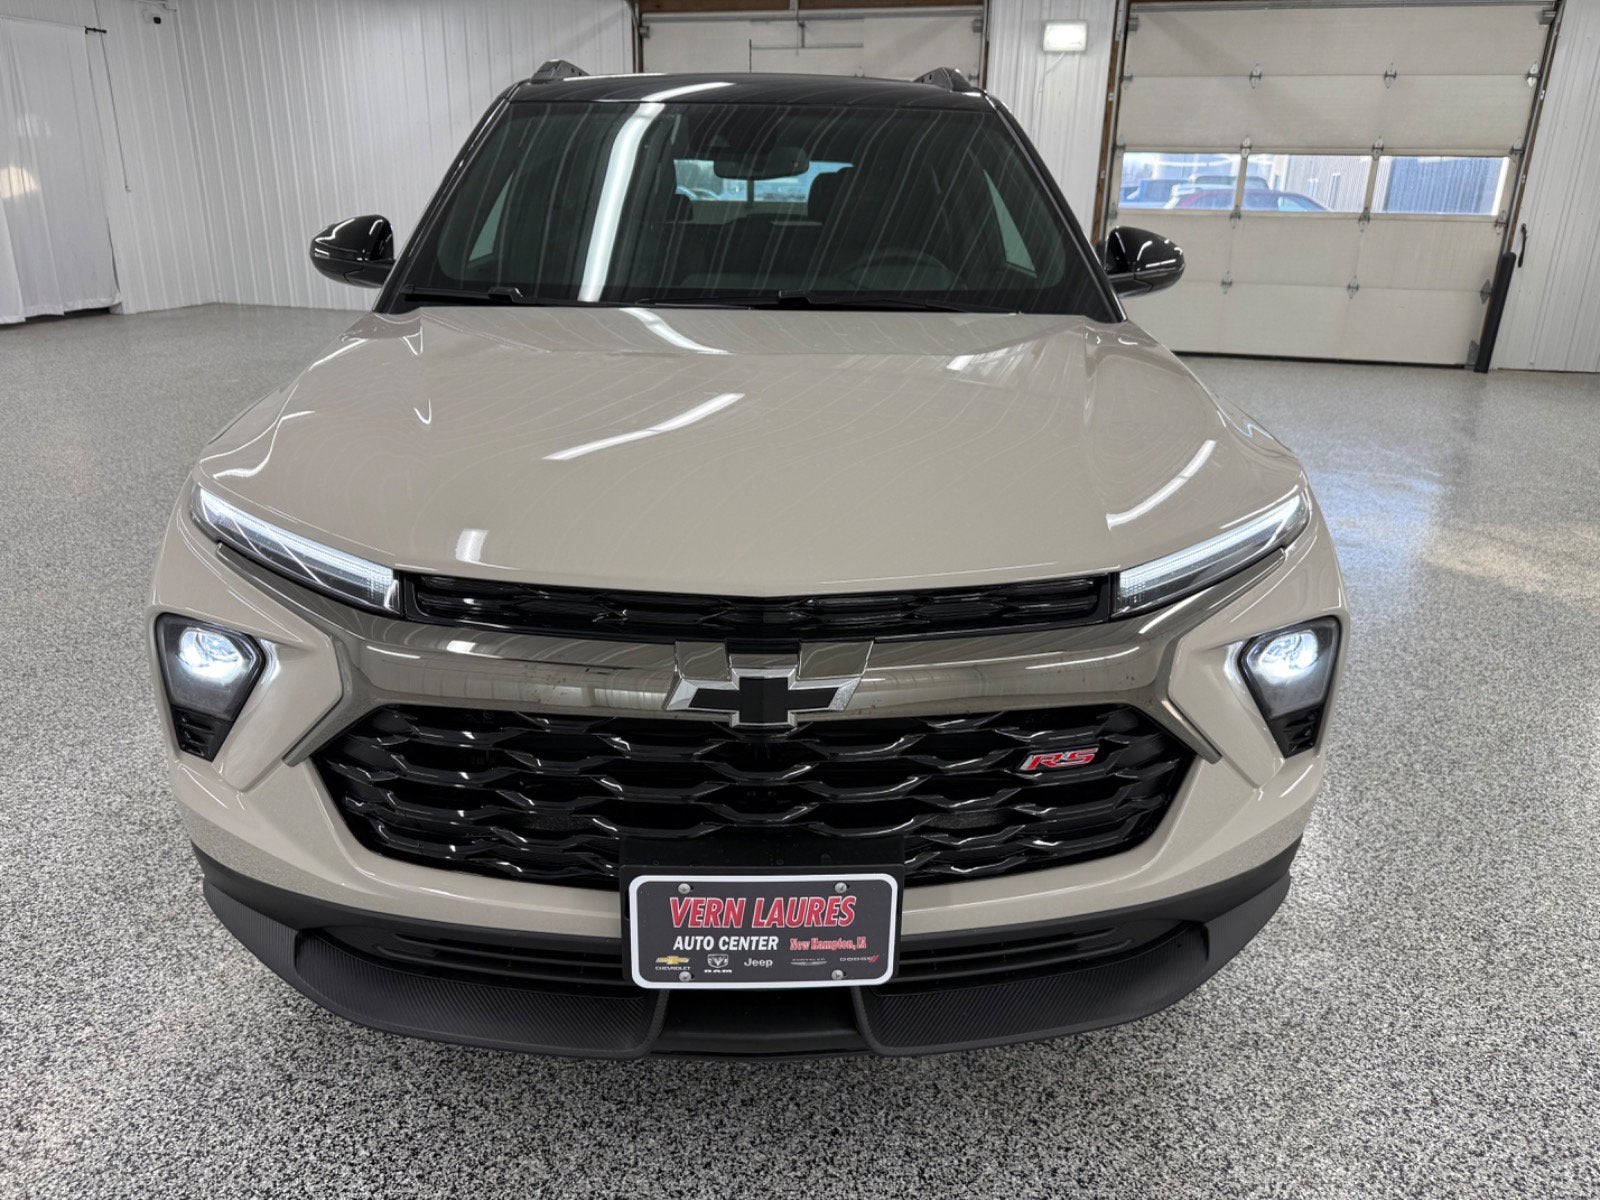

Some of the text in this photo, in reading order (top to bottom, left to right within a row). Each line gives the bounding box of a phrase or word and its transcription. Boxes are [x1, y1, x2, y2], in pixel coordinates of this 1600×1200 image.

[1020, 747, 1099, 771] RS
[669, 896, 857, 928] VERN LAURES
[673, 936, 779, 951] AUTO CENTER
[789, 938, 810, 951] New
[811, 937, 856, 951] Hampton,
[743, 958, 773, 968] Jeep
